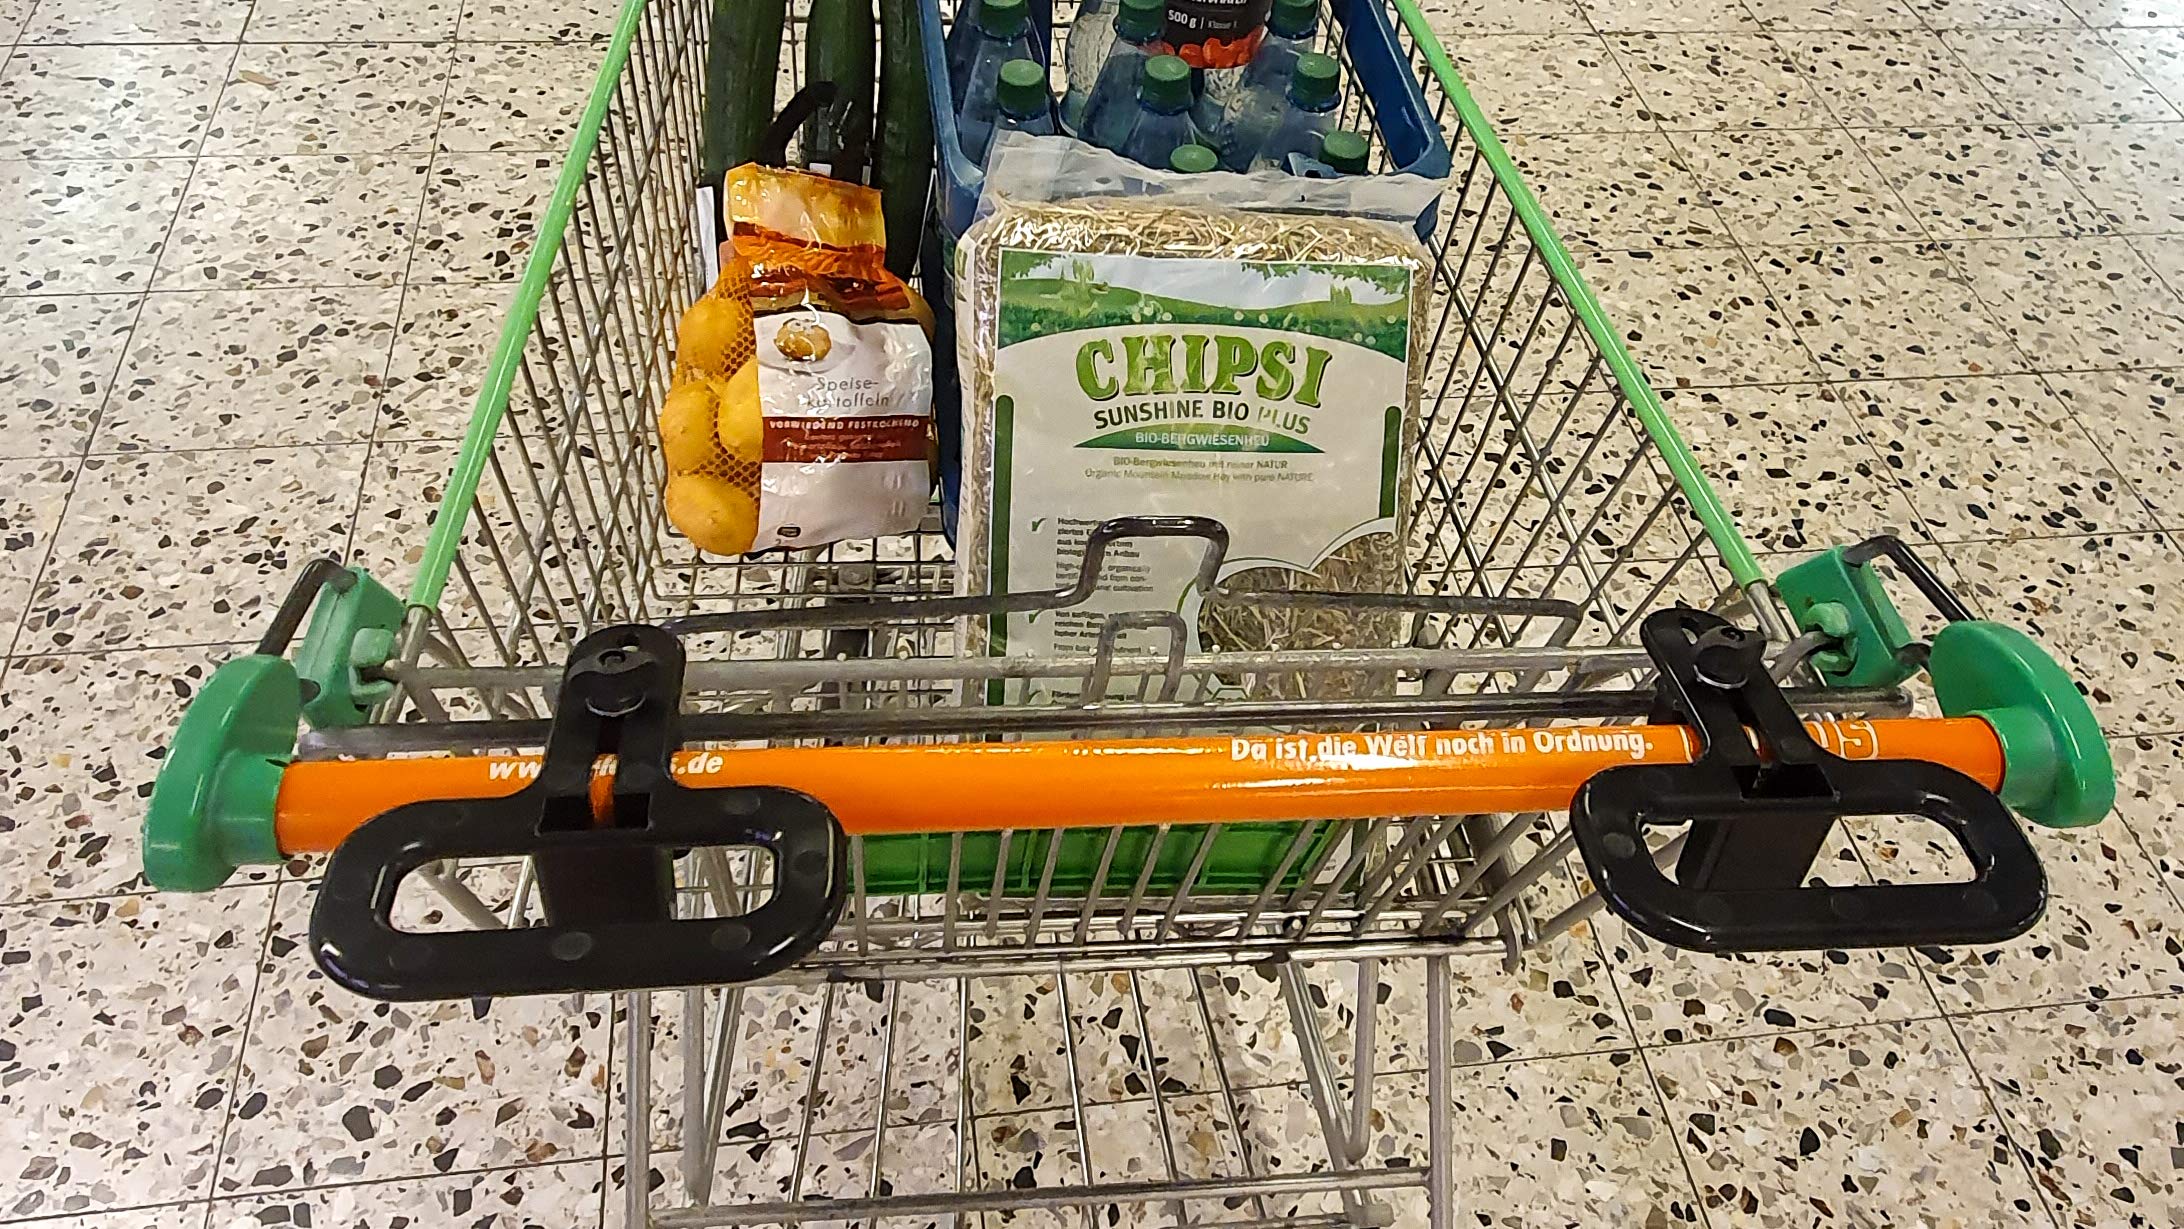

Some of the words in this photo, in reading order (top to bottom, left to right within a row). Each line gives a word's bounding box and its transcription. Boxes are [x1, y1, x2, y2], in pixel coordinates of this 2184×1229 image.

[1167, 9, 1189, 25] 500
[1188, 17, 1197, 29] g
[1075, 333, 1333, 408] CHIPSI
[816, 376, 879, 391] Speise-
[1093, 399, 1204, 430] SUNSHINE
[1213, 399, 1249, 421] BIO
[1258, 406, 1311, 434] PLUS
[1135, 432, 1270, 447] BIO-BERGWIESENHEU
[1256, 460, 1289, 469] NATUR
[1278, 473, 1314, 482] NATURE
[1230, 737, 1268, 761] Da
[1275, 736, 1309, 762] ist
[1317, 734, 1358, 759] die
[1364, 733, 1428, 757] Welt
[1435, 731, 1495, 756] noch
[1501, 730, 1527, 754] in
[1532, 729, 1655, 760] Ordnung.
